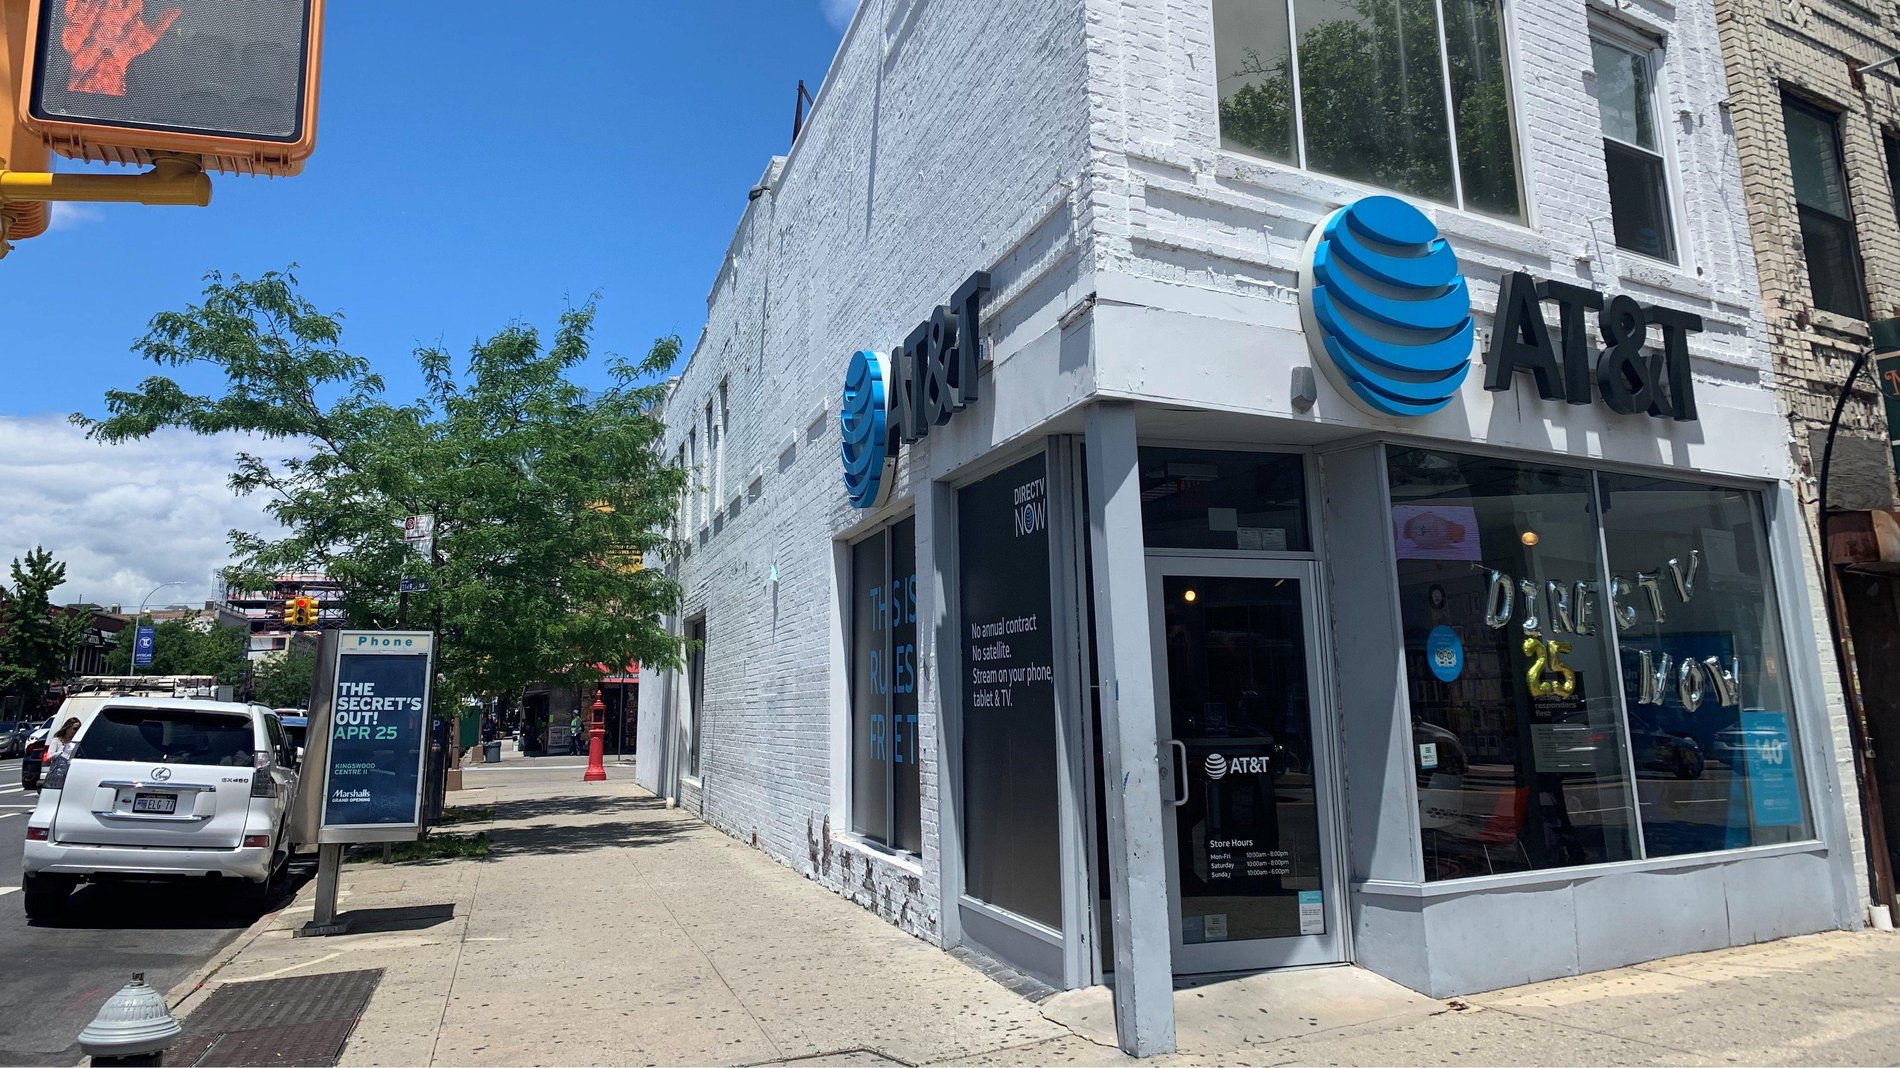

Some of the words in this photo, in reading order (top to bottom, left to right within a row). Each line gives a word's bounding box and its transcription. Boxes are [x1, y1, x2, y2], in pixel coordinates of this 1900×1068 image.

[1484, 271, 1703, 421] AT&T
[884, 270, 991, 457] AT&T
[1014, 477, 1045, 506] DIRECTV
[1014, 498, 1046, 538] NOW
[971, 622, 981, 639] No
[982, 617, 1005, 638] annual
[1005, 613, 1037, 634] contract
[358, 636, 413, 647] Phone
[972, 645, 982, 661] No
[982, 641, 1012, 660] satellite.
[972, 667, 997, 684] Stream
[998, 668, 1008, 683] on
[1008, 667, 1026, 687] your
[1027, 661, 1053, 687] phone,
[1522, 637, 1576, 700] 25
[339, 682, 375, 696] THE
[337, 697, 422, 711] SECRET'S
[973, 688, 994, 707] tablet
[994, 689, 1000, 707] &
[1001, 688, 1013, 707] TV.
[1534, 701, 1577, 710] responders
[335, 711, 378, 725] OUT!
[432, 719, 441, 731] P
[334, 726, 371, 740] APR
[374, 726, 398, 740] 25
[1230, 756, 1270, 774] AT&T
[332, 789, 371, 798] Marshalls
[147, 799, 162, 810] ELG
[165, 799, 175, 810] 77
[1210, 839, 1231, 848] Store
[1231, 838, 1254, 847] Hours
[1270, 850, 1289, 858] 8:00pm
[1210, 862, 1235, 870] Saturday
[1270, 859, 1290, 867] 8:00pm
[1271, 868, 1290, 876] 6:00pm
